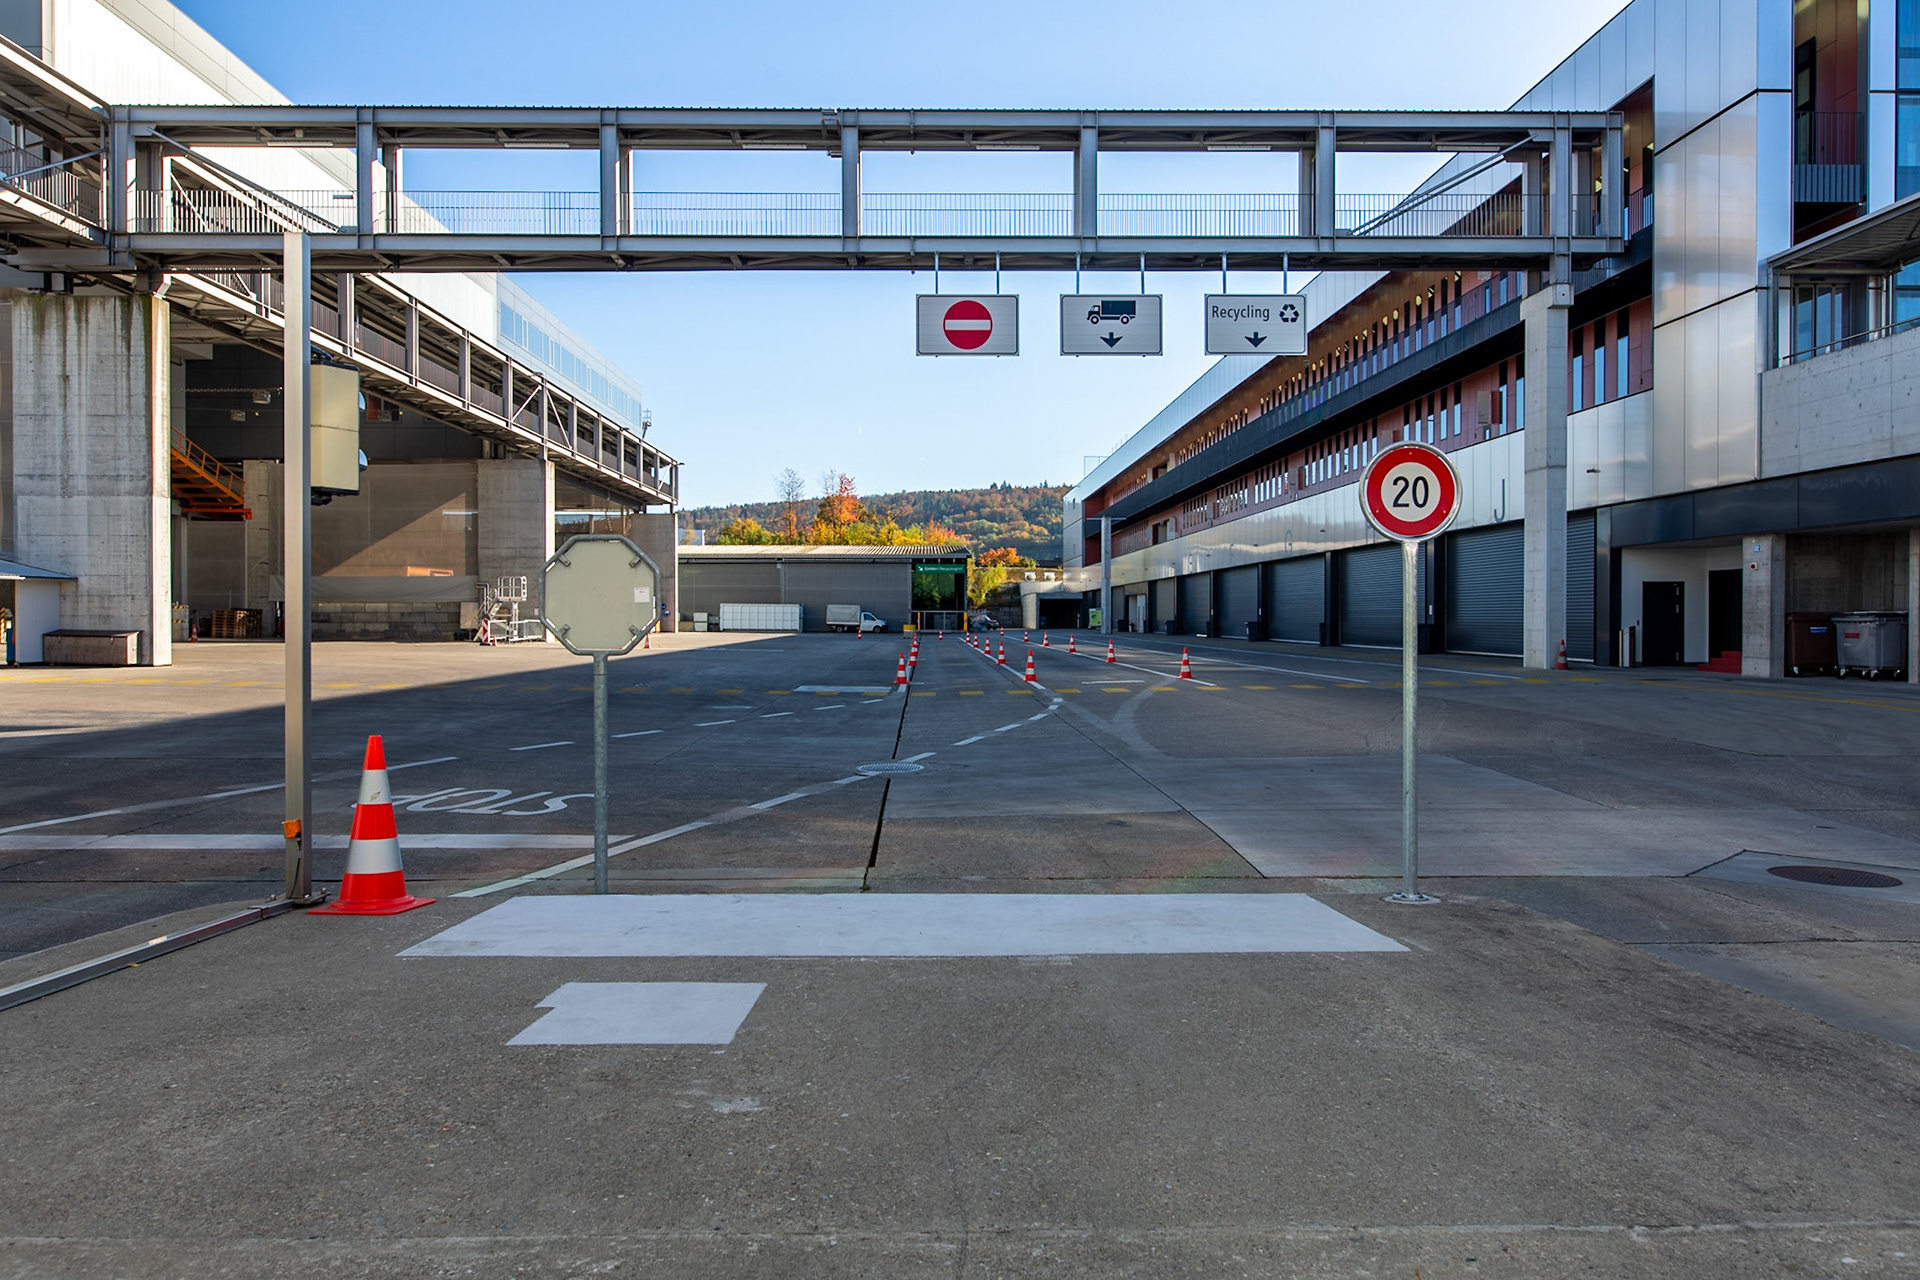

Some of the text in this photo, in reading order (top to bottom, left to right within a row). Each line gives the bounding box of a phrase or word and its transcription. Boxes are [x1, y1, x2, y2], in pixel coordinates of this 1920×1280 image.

[1212, 304, 1270, 322] Recycling
[1392, 475, 1429, 508] 20
[1493, 478, 1506, 523] J
